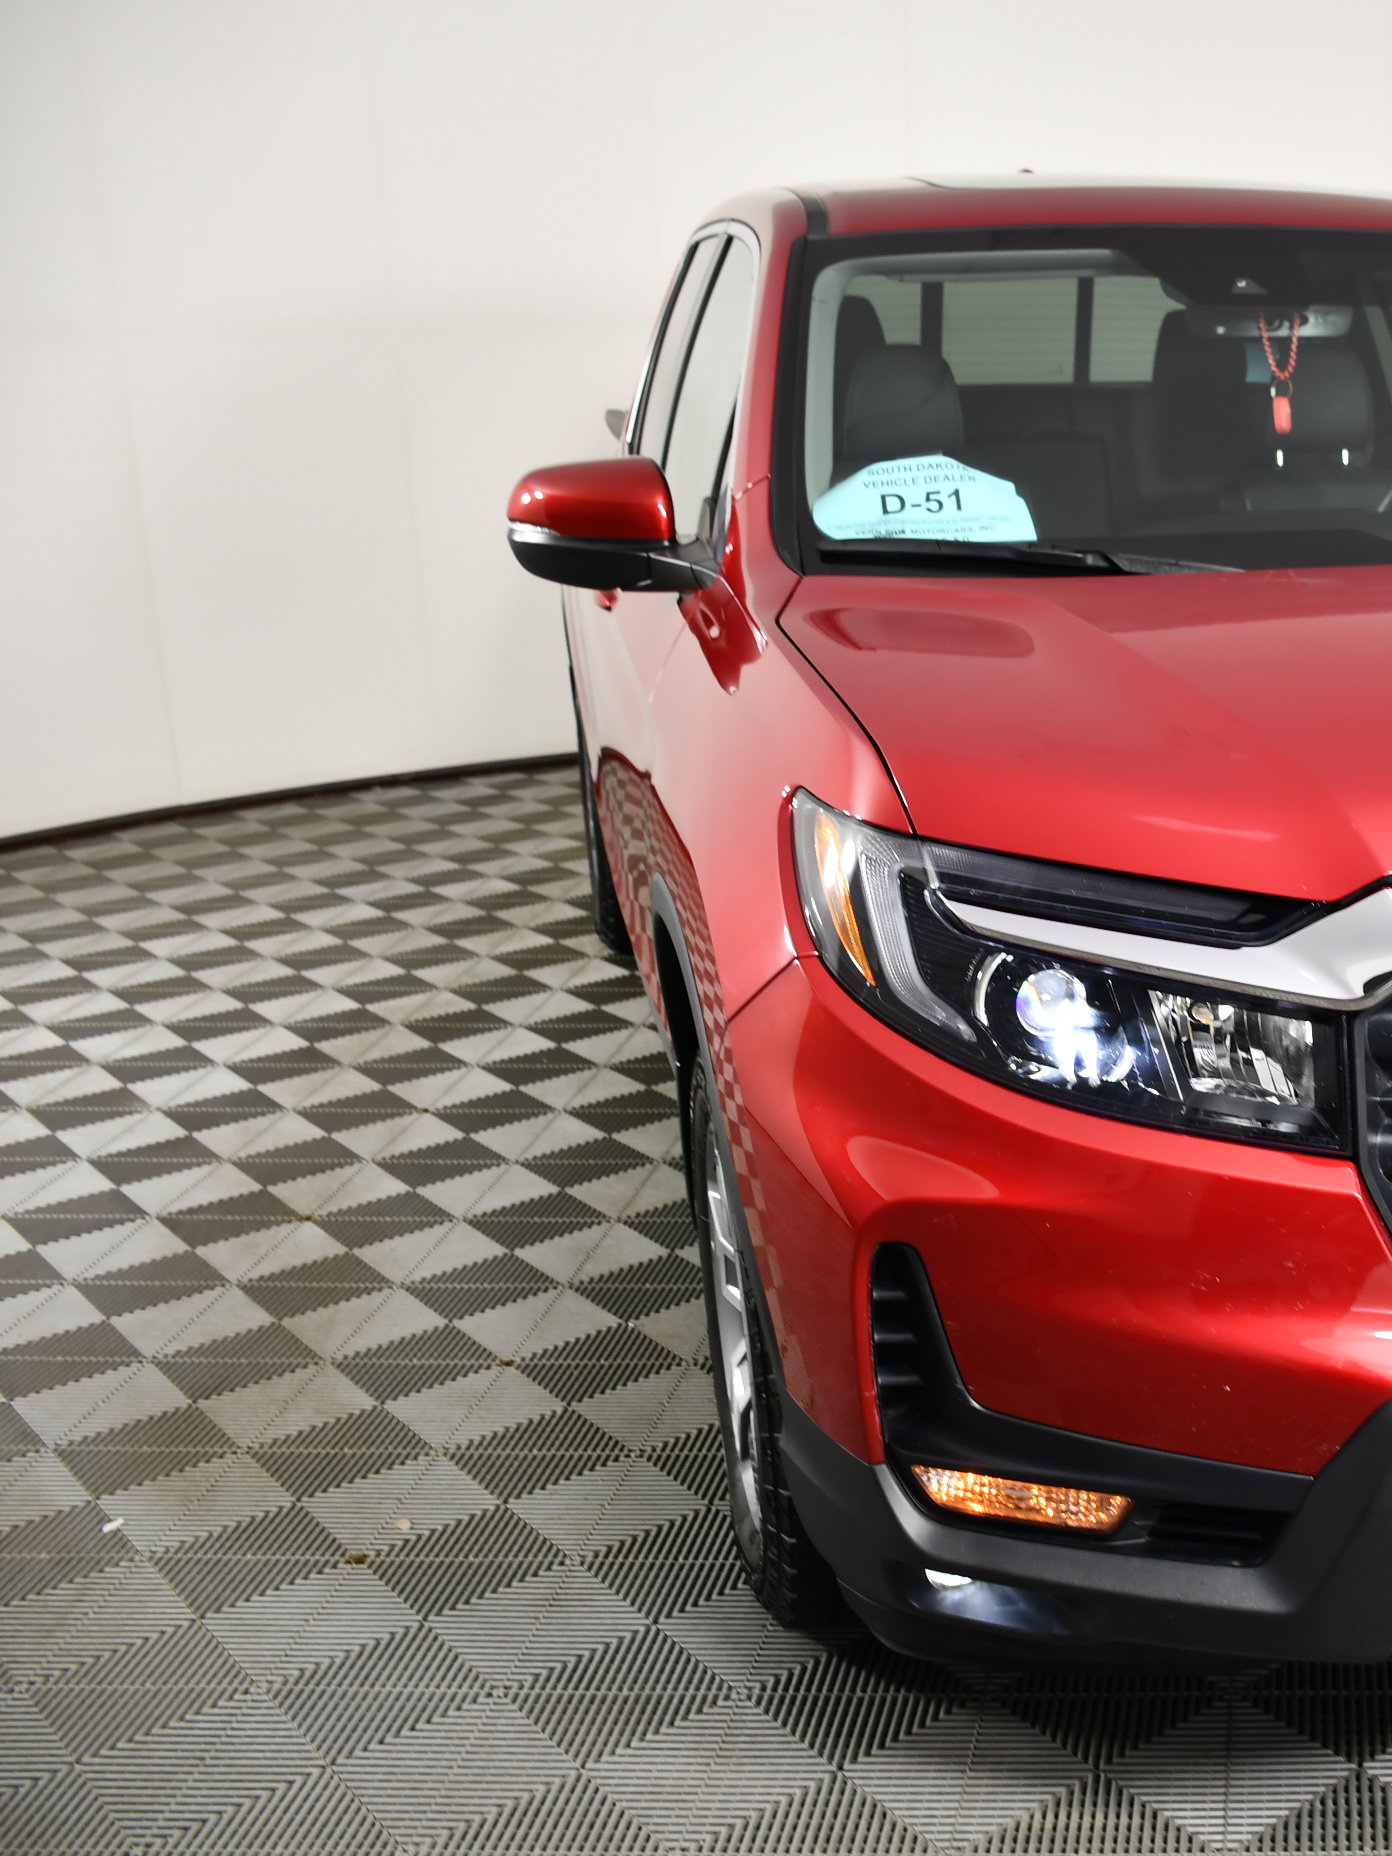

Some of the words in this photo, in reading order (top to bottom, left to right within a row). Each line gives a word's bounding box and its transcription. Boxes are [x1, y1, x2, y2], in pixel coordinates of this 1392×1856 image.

[867, 464, 912, 477] SOUTH
[863, 477, 919, 489] VEHICLE
[924, 474, 977, 485] DEALER
[880, 488, 963, 515] D-51
